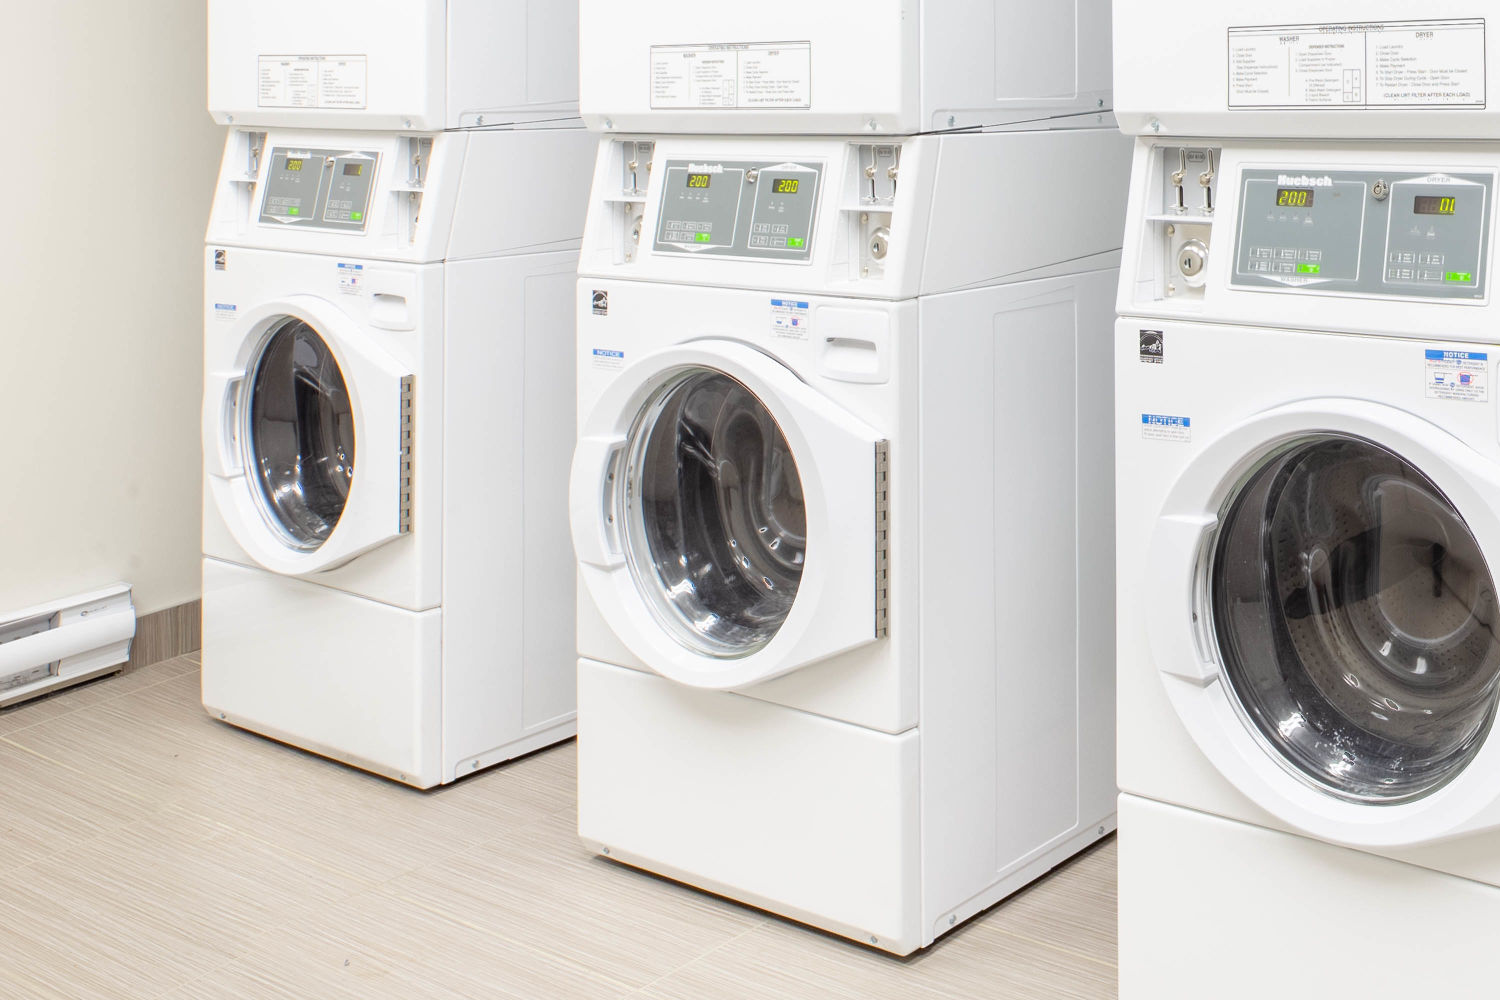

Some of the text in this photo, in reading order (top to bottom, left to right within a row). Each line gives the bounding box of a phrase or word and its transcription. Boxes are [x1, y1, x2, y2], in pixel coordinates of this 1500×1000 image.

[689, 175, 708, 187] 200
[778, 180, 798, 192] 200
[1277, 174, 1333, 187] Huebsch
[1278, 190, 1307, 206] 200
[1443, 351, 1469, 359] NOTICE
[1148, 415, 1184, 427] NOTICE
